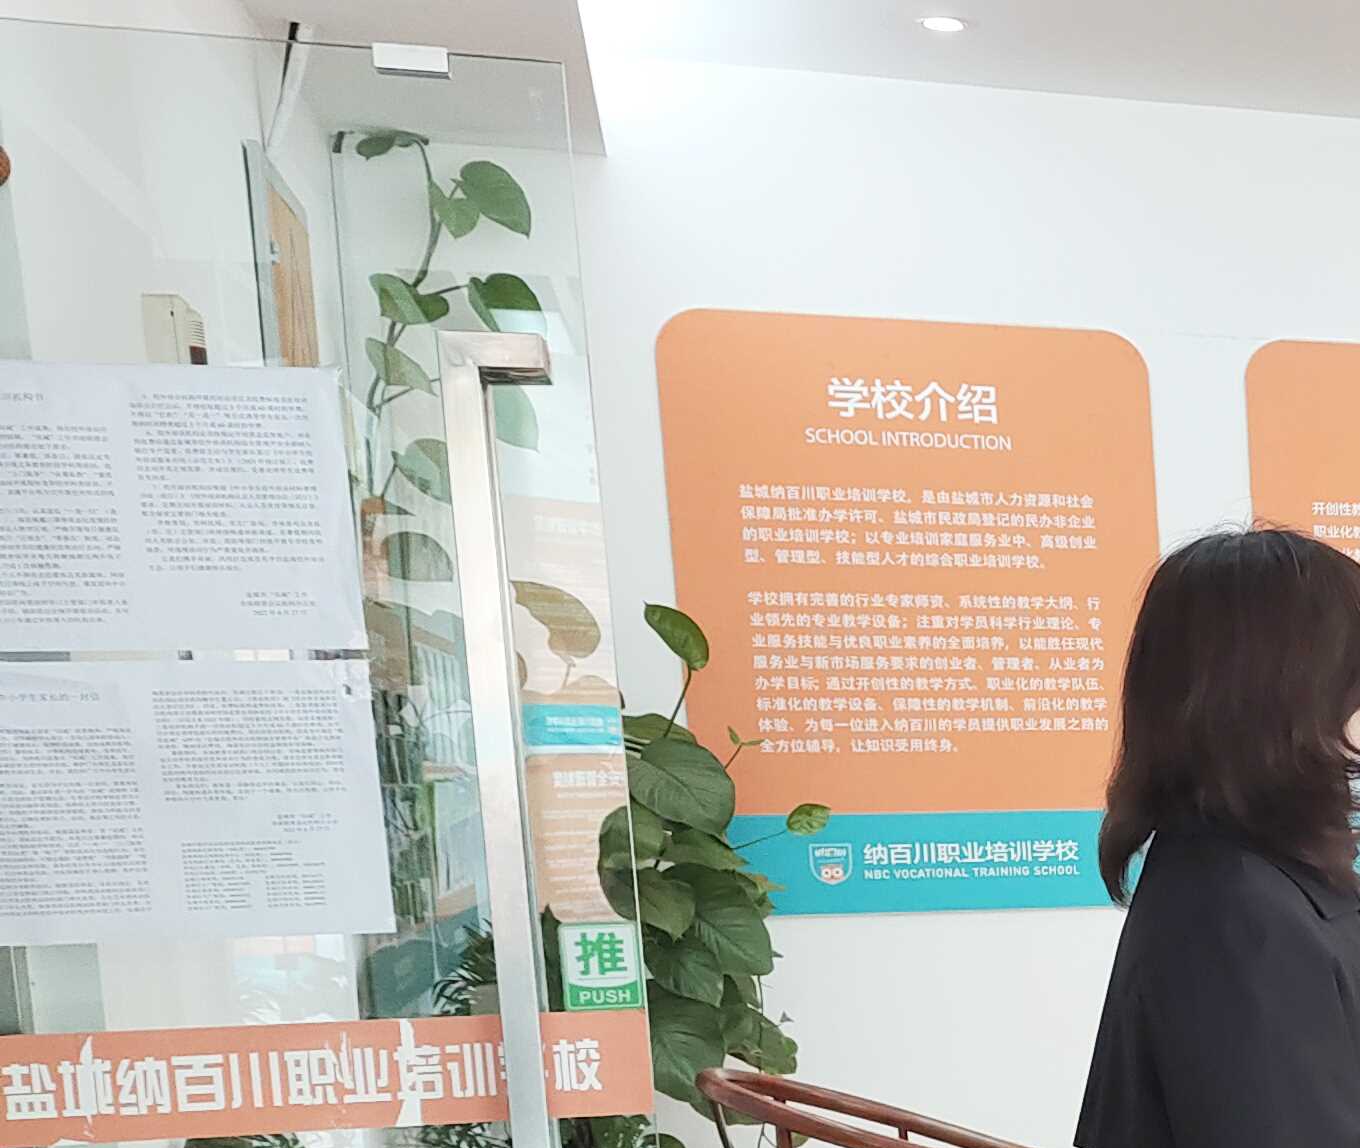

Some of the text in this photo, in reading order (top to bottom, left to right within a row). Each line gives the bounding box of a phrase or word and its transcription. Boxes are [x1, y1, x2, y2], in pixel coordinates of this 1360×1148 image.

[827, 377, 998, 425] 学校介绍
[805, 427, 1012, 451] SCHOOL INTRODUCTION
[863, 840, 1080, 865] 纳百川职业培训学校
[864, 864, 1080, 880] NBC VOCATIONAL TRAINING SCHOOL
[575, 932, 627, 975] 推
[579, 989, 631, 1004] PUSH
[1, 1038, 602, 1120] 盐城纳百川职业培训校
